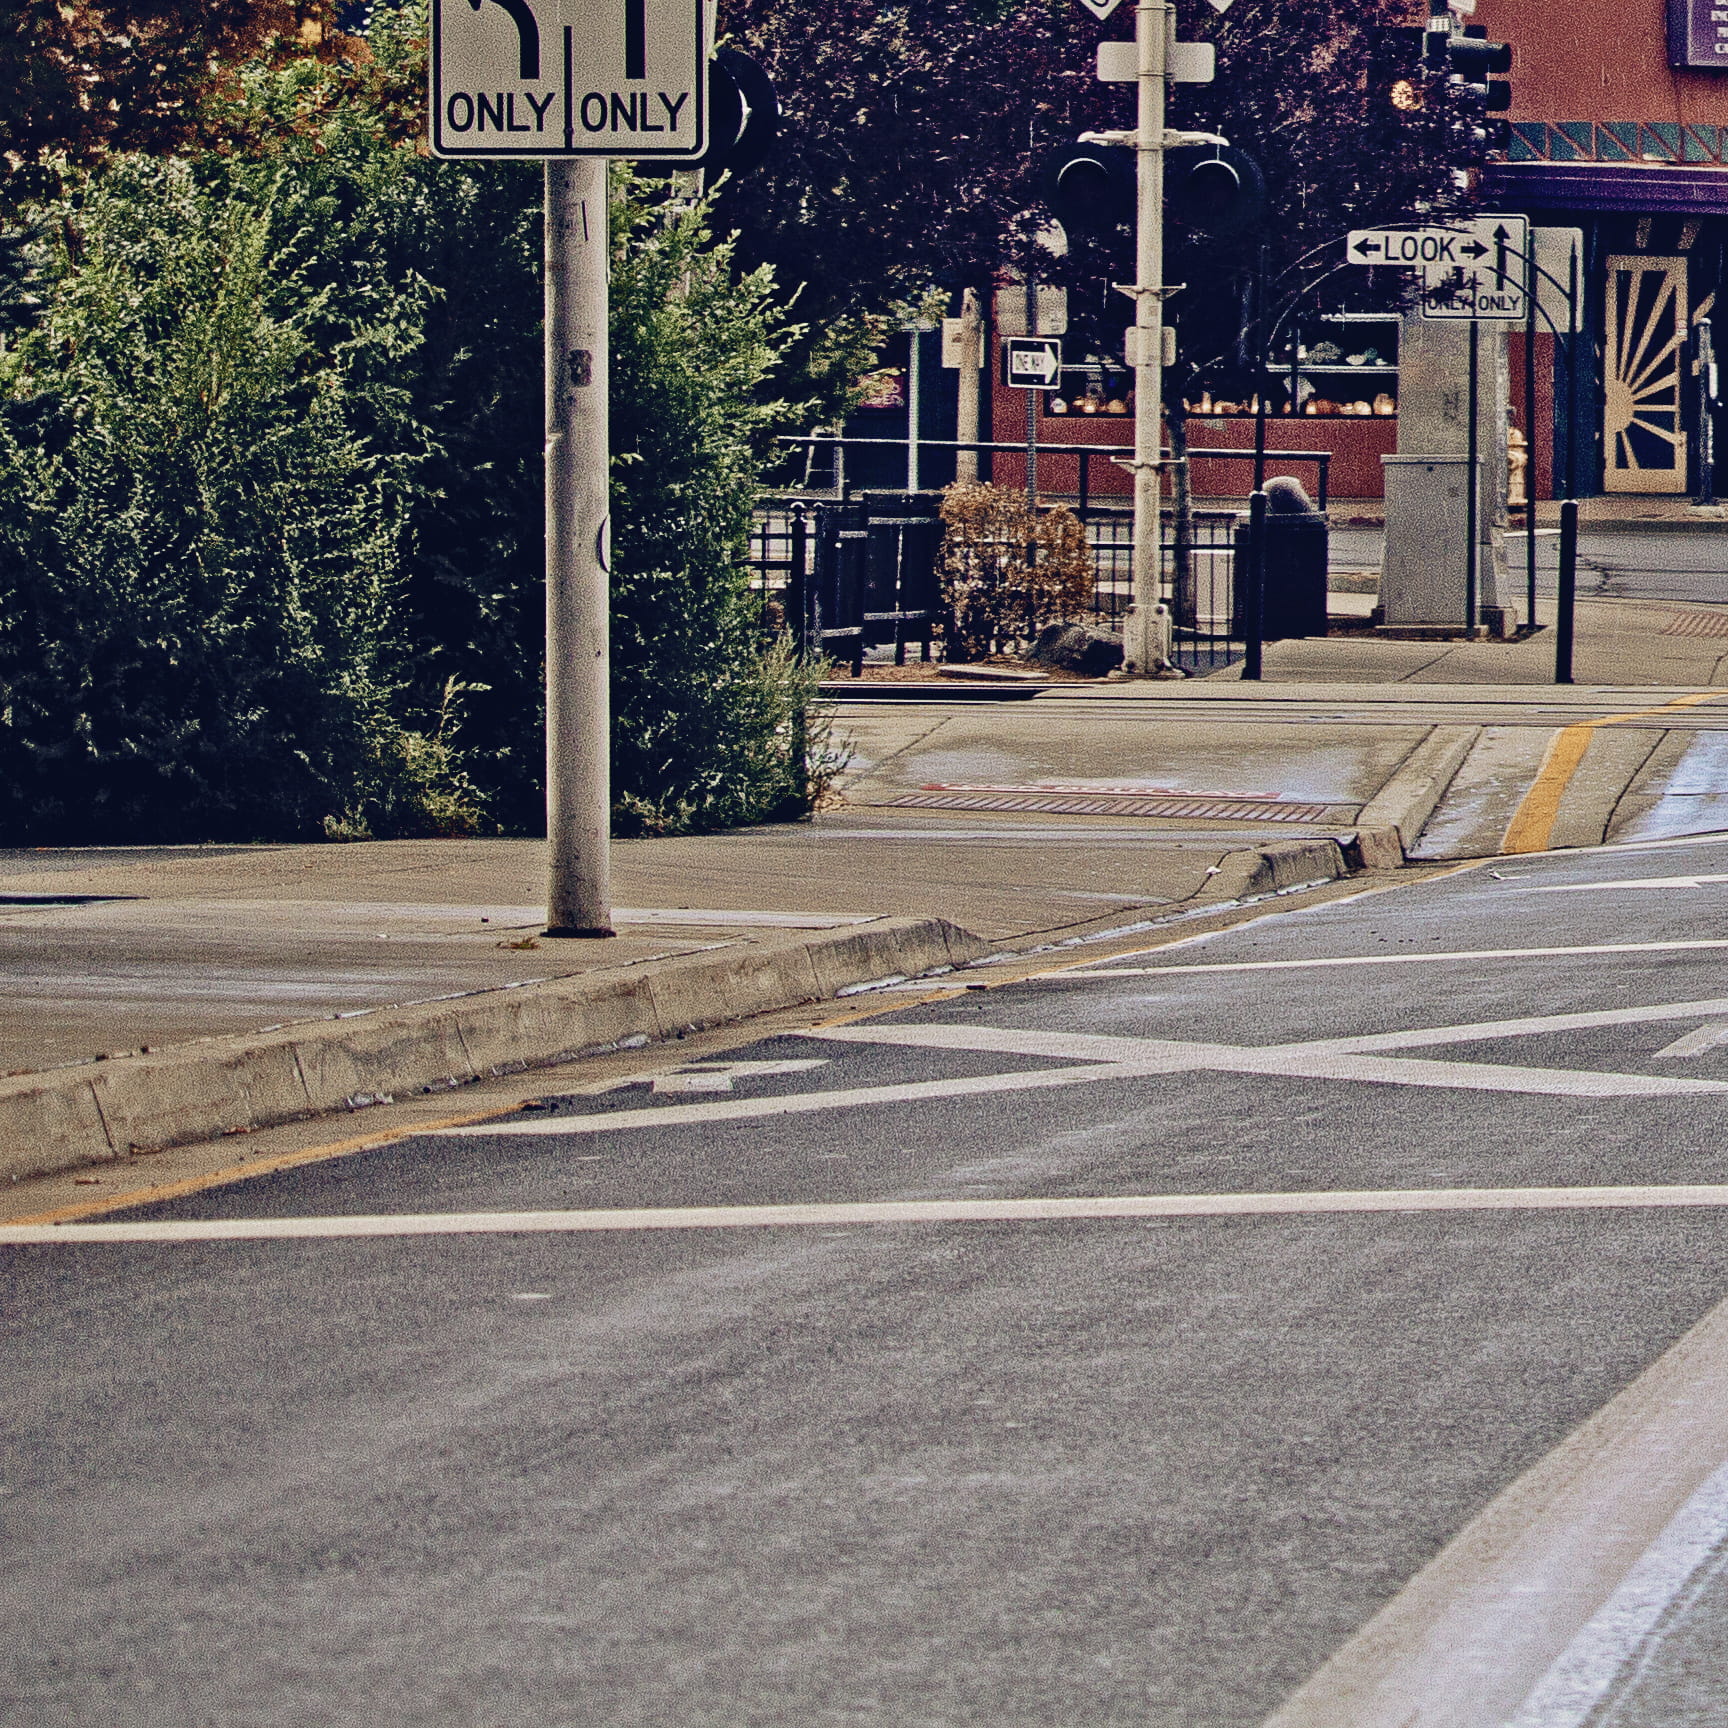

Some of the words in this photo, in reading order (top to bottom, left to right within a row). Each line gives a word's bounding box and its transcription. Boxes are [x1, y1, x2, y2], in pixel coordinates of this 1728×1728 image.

[447, 92, 556, 133] ONLY
[580, 92, 689, 133] ONLY
[1385, 235, 1457, 262] LOOK
[1479, 295, 1520, 311] ONLY
